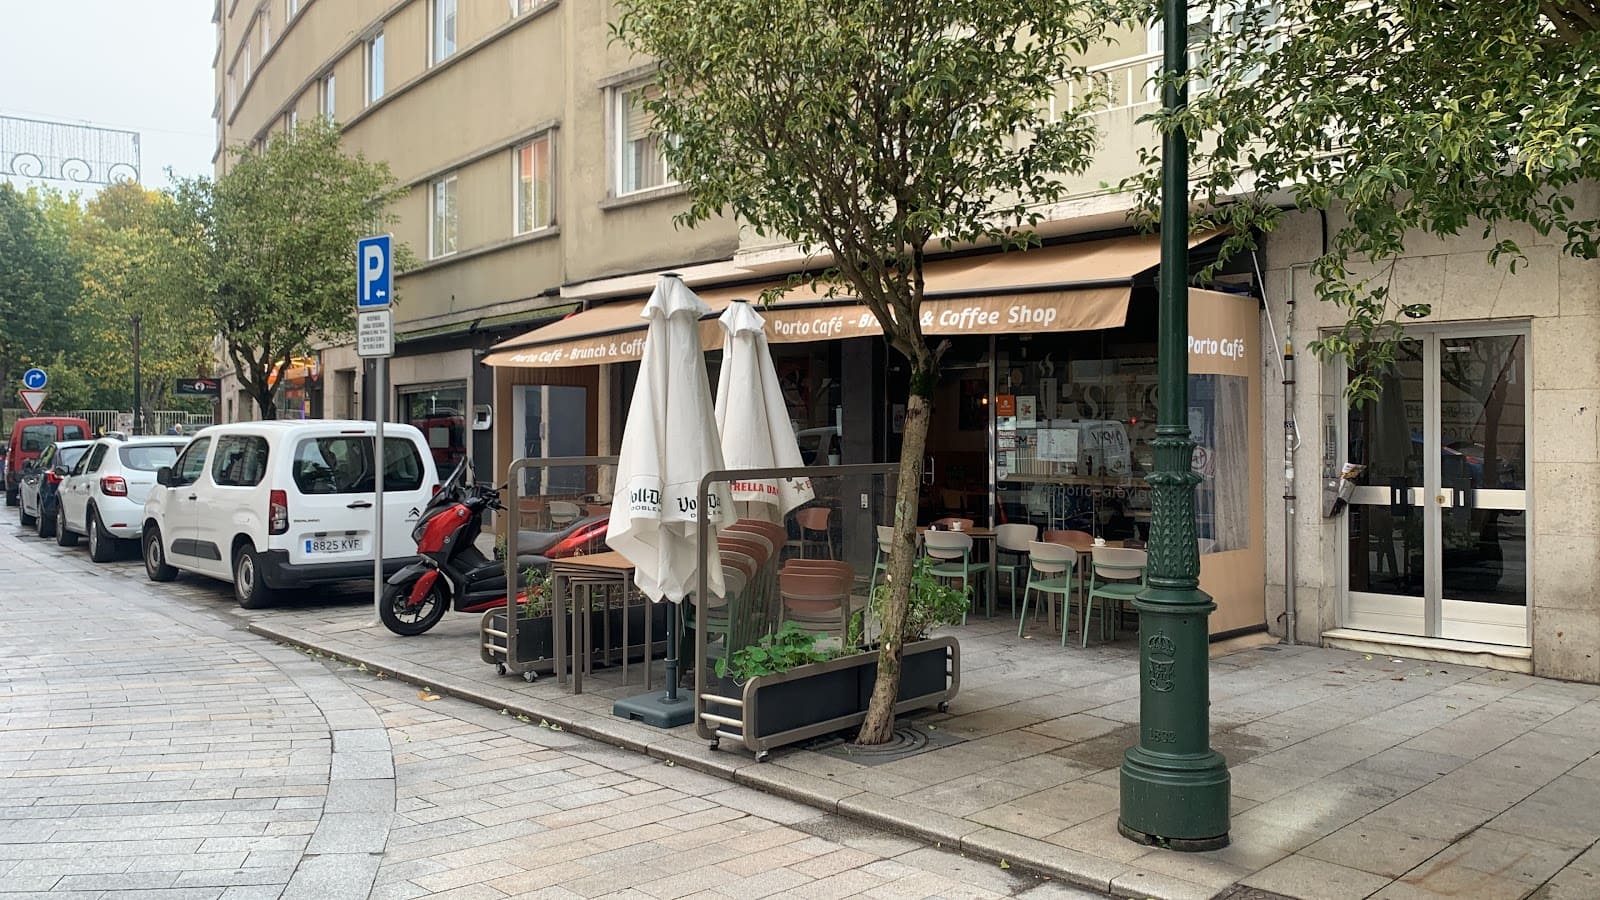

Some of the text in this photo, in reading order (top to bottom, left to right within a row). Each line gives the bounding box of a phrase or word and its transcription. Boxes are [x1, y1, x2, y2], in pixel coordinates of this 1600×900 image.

[364, 244, 385, 301] P
[774, 320, 809, 335] Porto
[812, 316, 843, 336] Café
[920, 310, 934, 326] &
[939, 307, 1000, 329] Coffee
[1007, 305, 1057, 327] Shop
[538, 348, 563, 364] Café
[569, 344, 606, 360] Brunch
[608, 343, 617, 356] &
[1188, 336, 1244, 361] Porto Café
[313, 539, 360, 551] 8825 KVF
